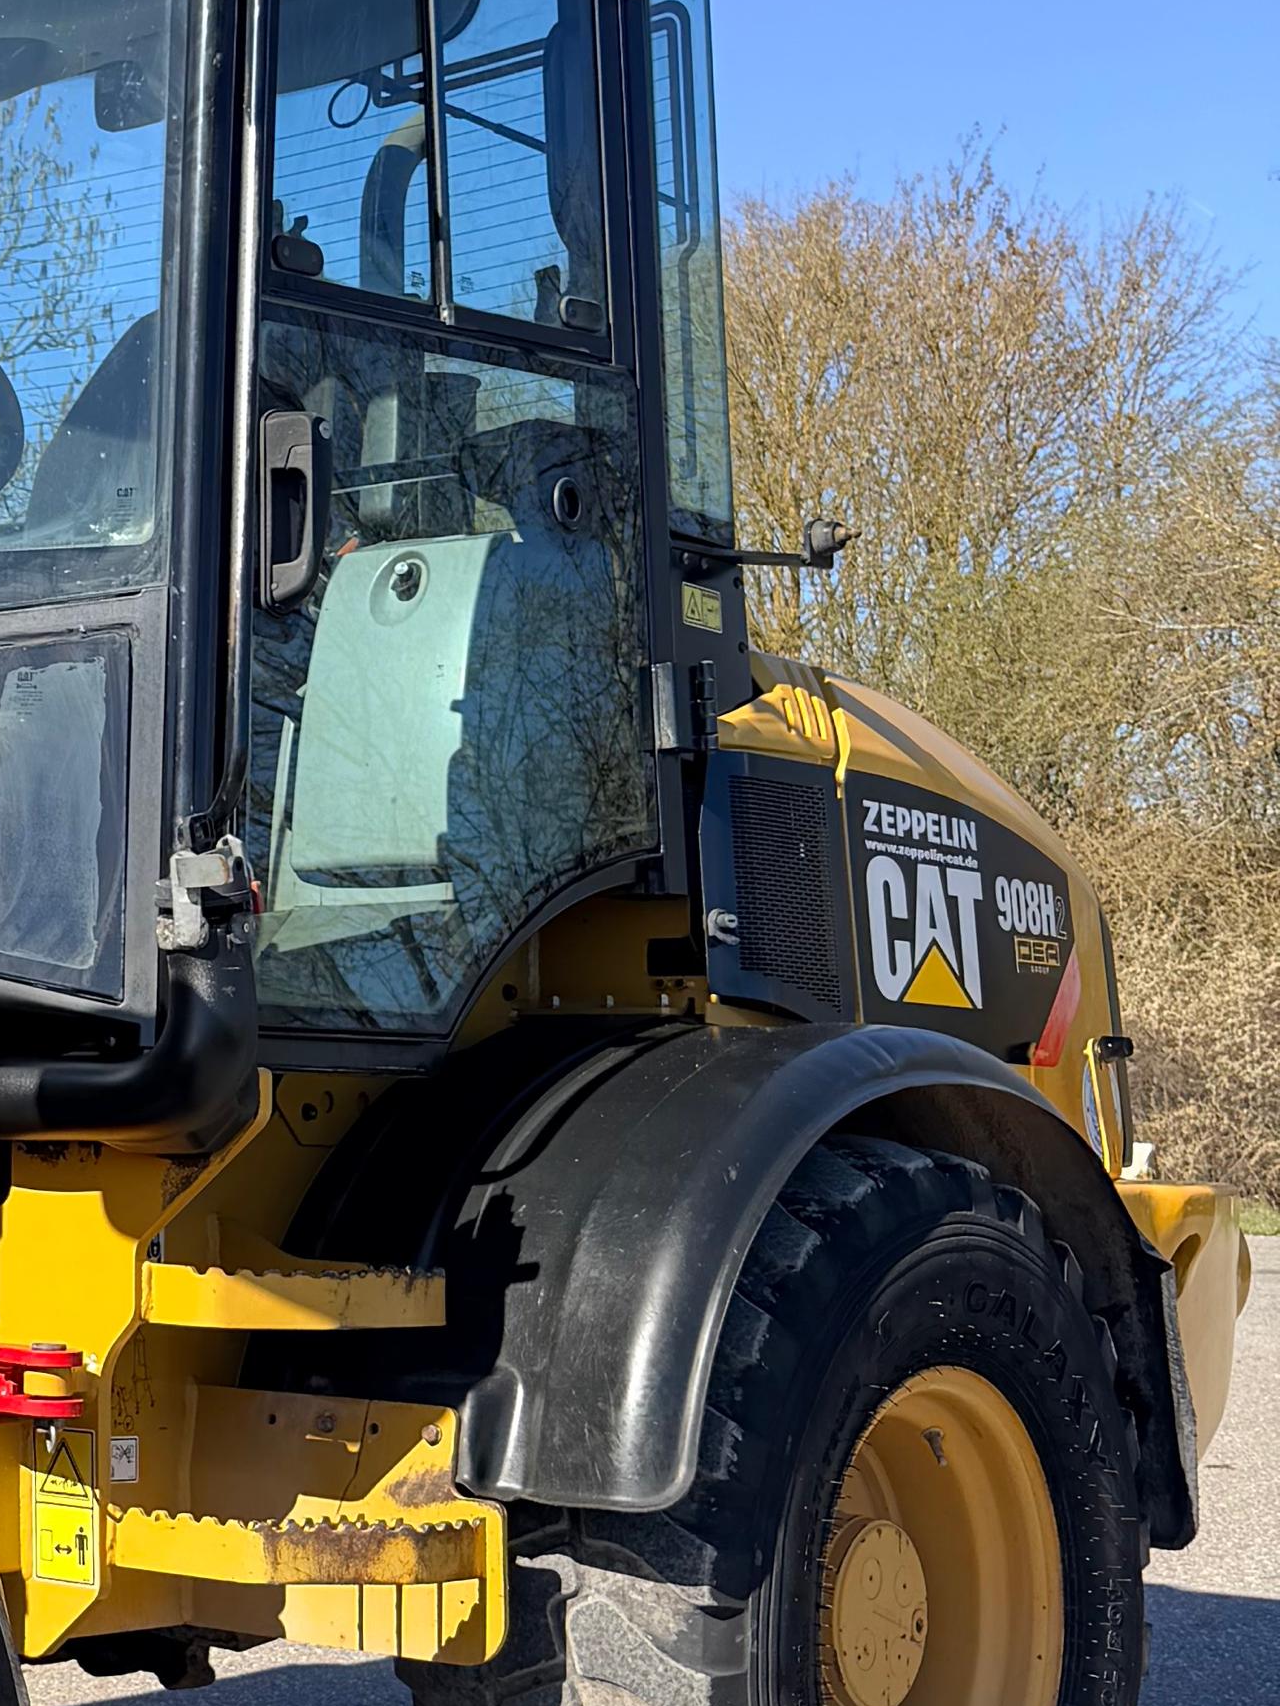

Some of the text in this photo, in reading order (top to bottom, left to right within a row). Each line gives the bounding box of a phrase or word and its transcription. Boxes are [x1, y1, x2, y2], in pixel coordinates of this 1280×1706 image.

[862, 799, 978, 852] ZEPPELIN
[864, 838, 979, 870] www.zeppelin-cat.de
[866, 855, 984, 1010] CAT
[962, 1278, 1119, 1476] GALAXY
